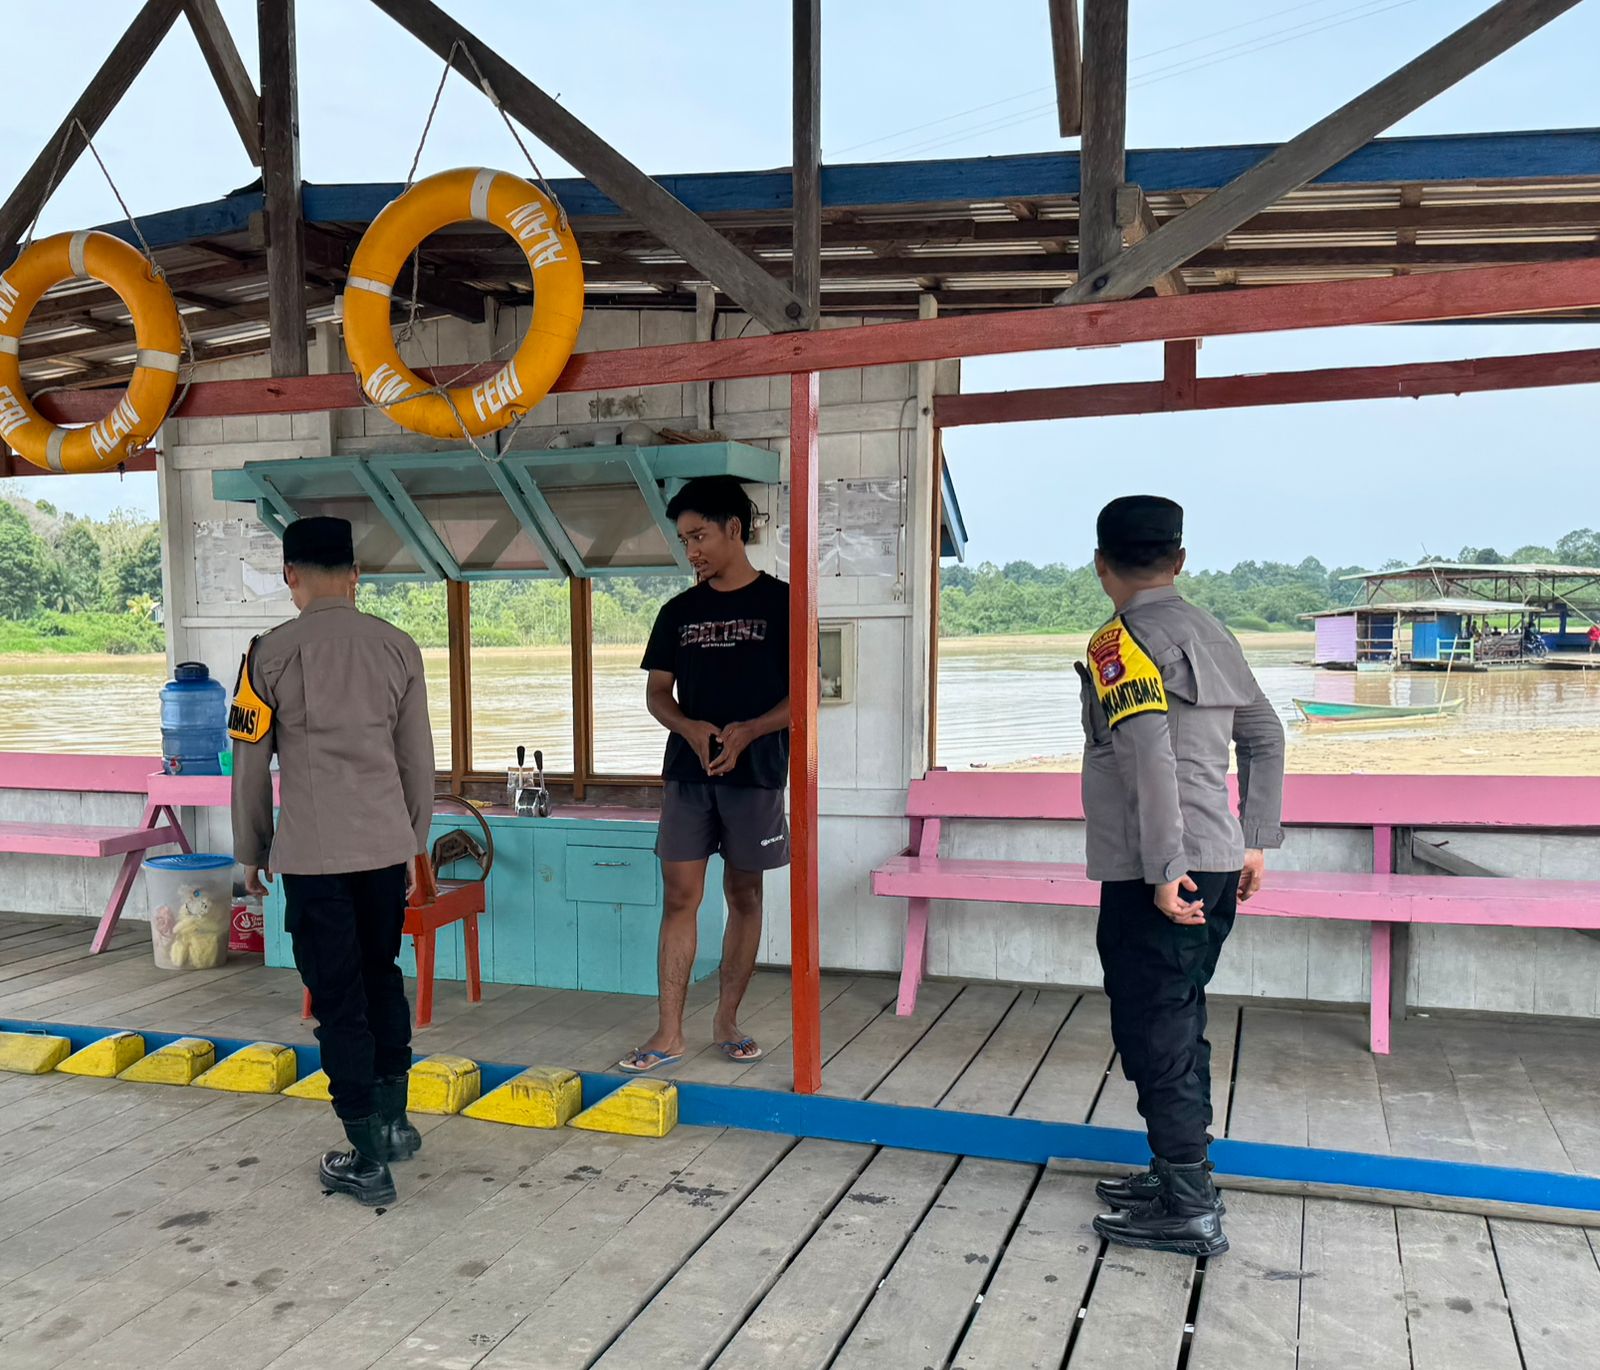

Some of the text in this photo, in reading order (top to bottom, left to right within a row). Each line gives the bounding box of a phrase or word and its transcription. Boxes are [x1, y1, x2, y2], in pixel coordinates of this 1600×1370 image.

[365, 201, 568, 423] KM FERI ALAN
[90, 391, 141, 460] ALAN
